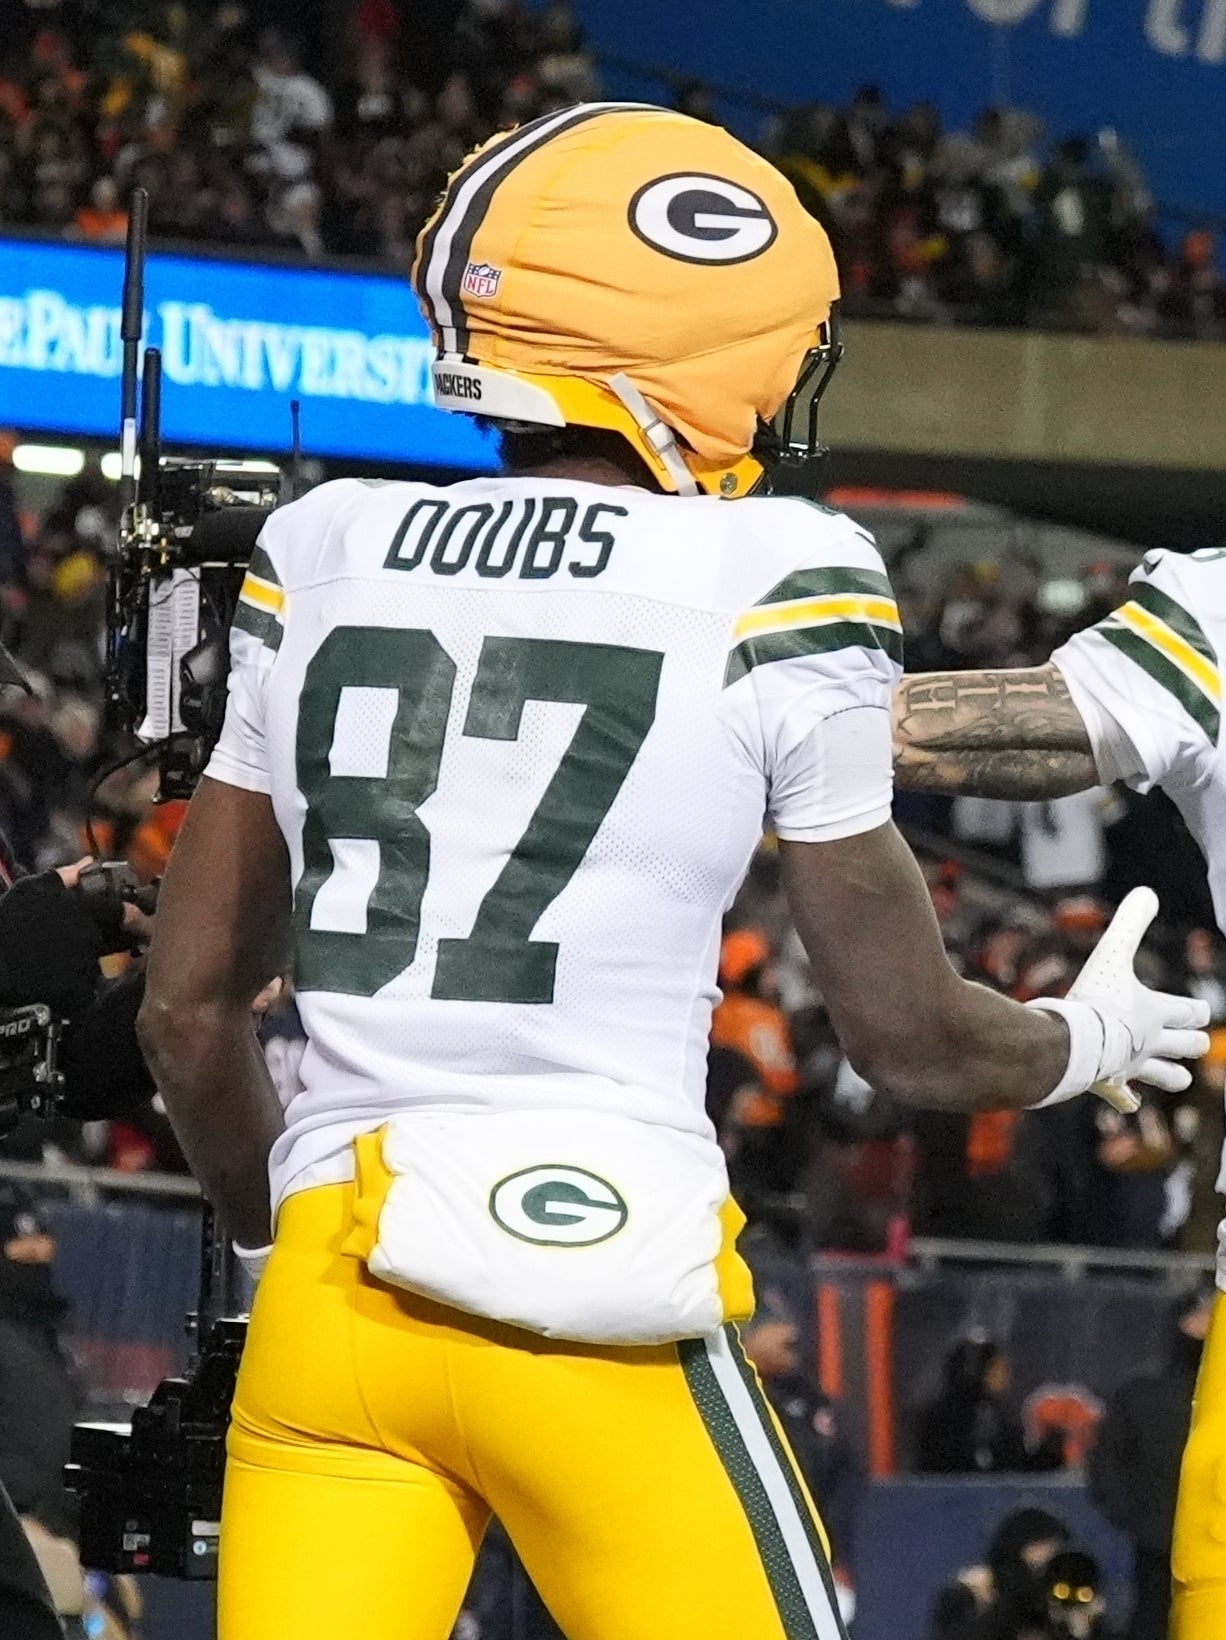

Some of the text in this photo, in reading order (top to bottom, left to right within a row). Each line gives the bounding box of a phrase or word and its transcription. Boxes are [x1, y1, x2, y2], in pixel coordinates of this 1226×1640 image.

[628, 172, 778, 266] G
[467, 275, 494, 295] NFL
[382, 497, 629, 579] DOUBS
[294, 625, 664, 1004] 87
[489, 1163, 628, 1247] G
